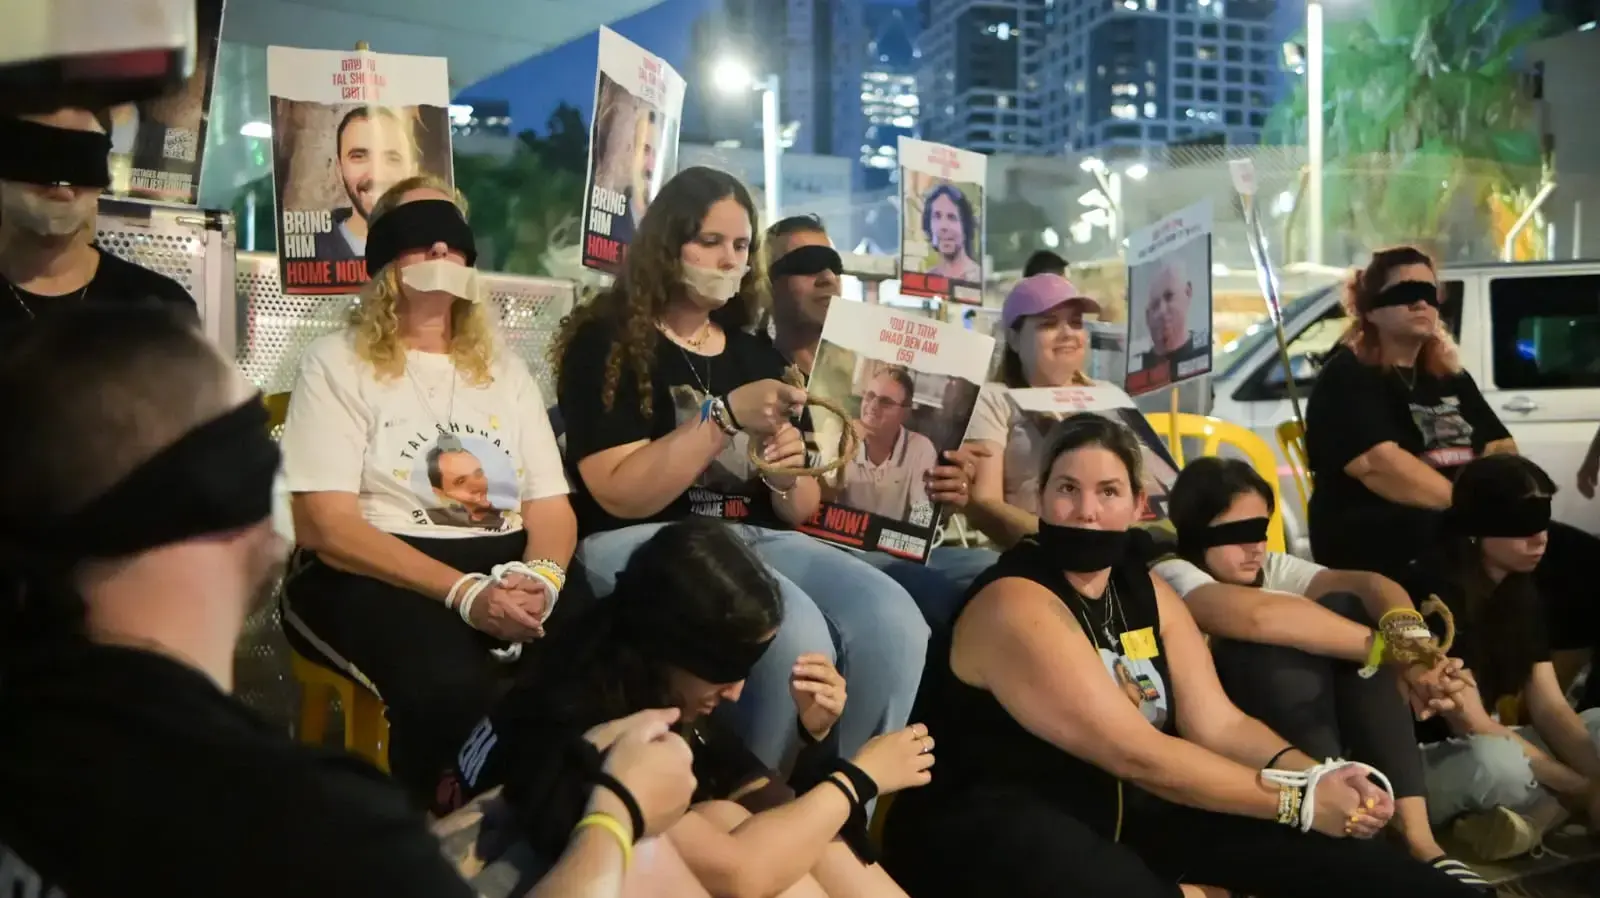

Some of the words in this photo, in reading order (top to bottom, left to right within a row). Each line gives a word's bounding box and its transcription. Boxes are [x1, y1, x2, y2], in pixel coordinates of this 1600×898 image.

[332, 73, 347, 86] TAL
[592, 184, 626, 216] BRING
[283, 210, 332, 234] BRING
[588, 208, 612, 236] HIM
[285, 235, 316, 258] HIM
[587, 234, 620, 262] HOME
[287, 261, 332, 284] HOME
[879, 329, 903, 346] OHAD
[904, 335, 921, 350] BEN
[921, 340, 939, 356] AMI
[896, 348, 915, 365] (55)
[400, 432, 428, 460] TAL
[824, 505, 870, 538] NOW!
